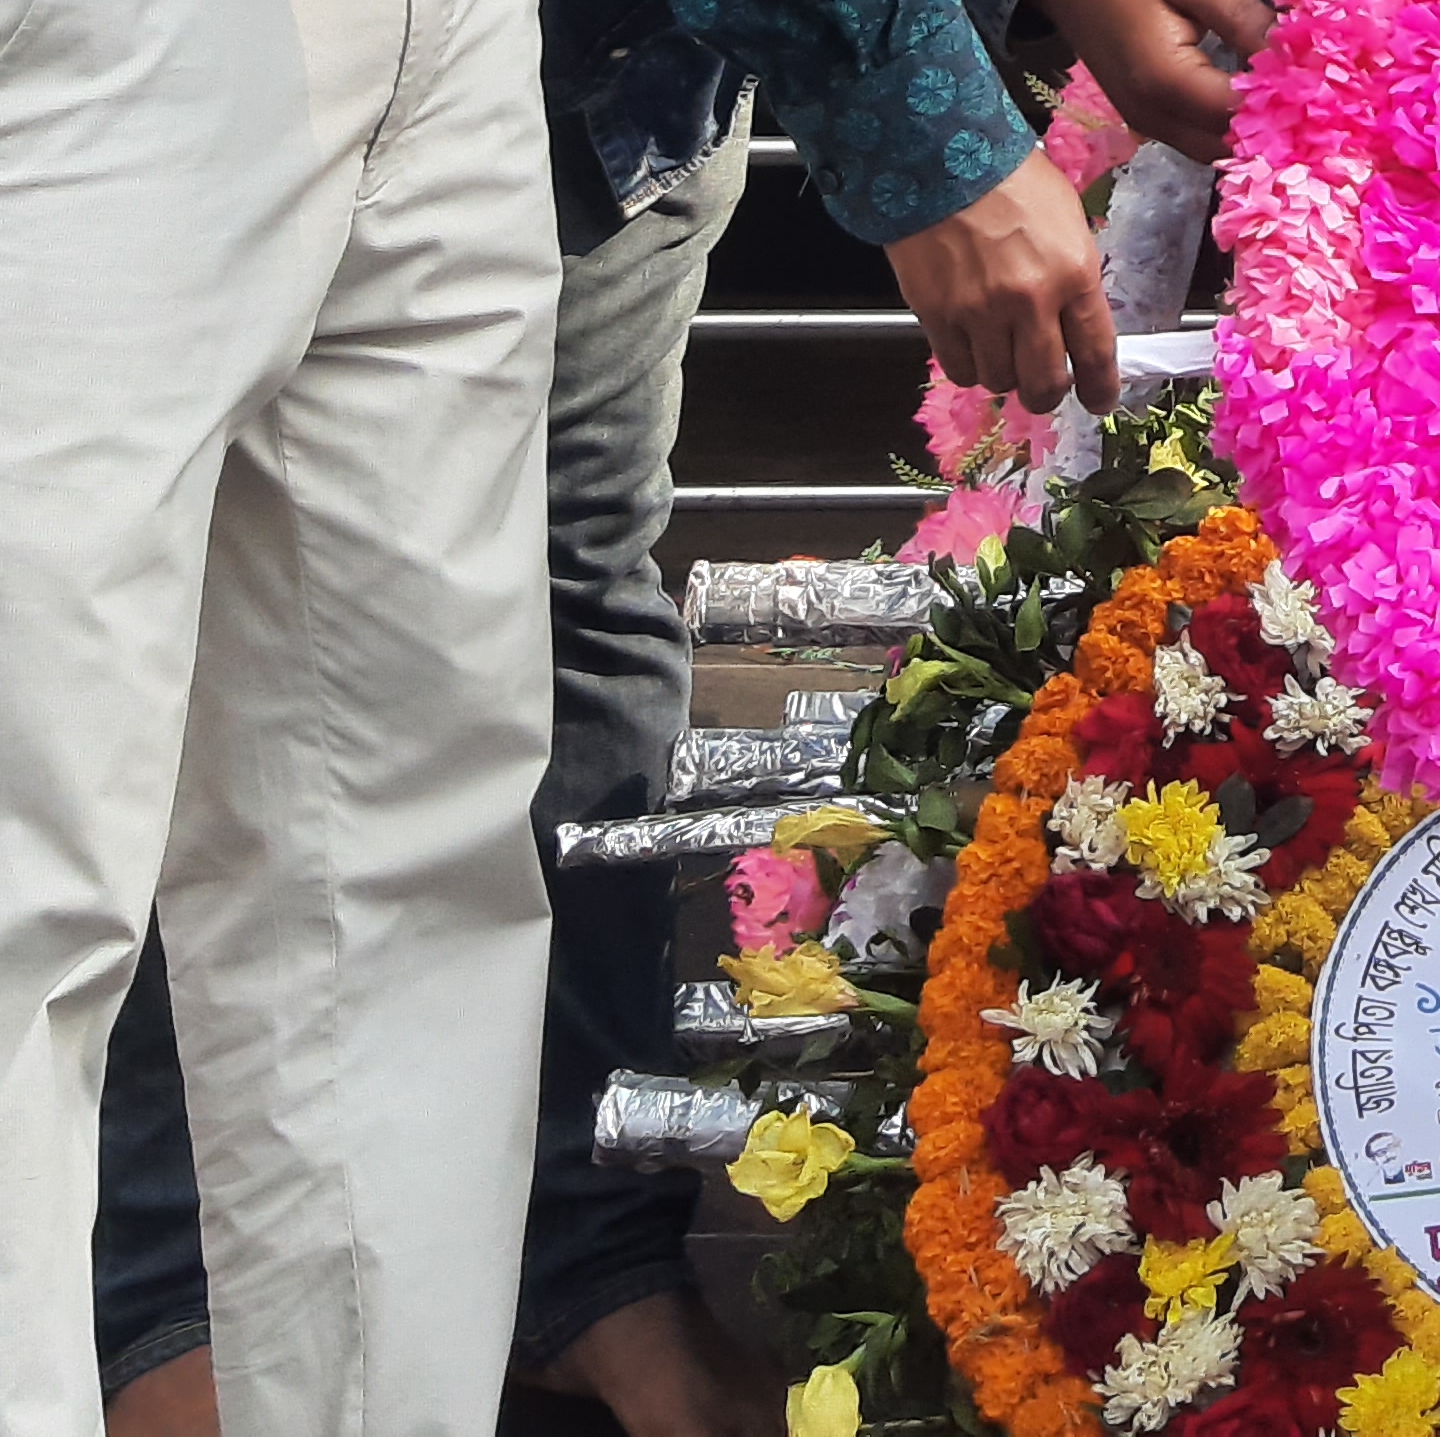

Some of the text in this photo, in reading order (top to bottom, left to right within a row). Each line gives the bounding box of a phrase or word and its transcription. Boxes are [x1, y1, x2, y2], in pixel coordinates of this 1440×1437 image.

[1360, 920, 1433, 992] বঙ্গবন্ধু
[1334, 994, 1398, 1043] পিতা
[1335, 1048, 1398, 1119] জাতির
